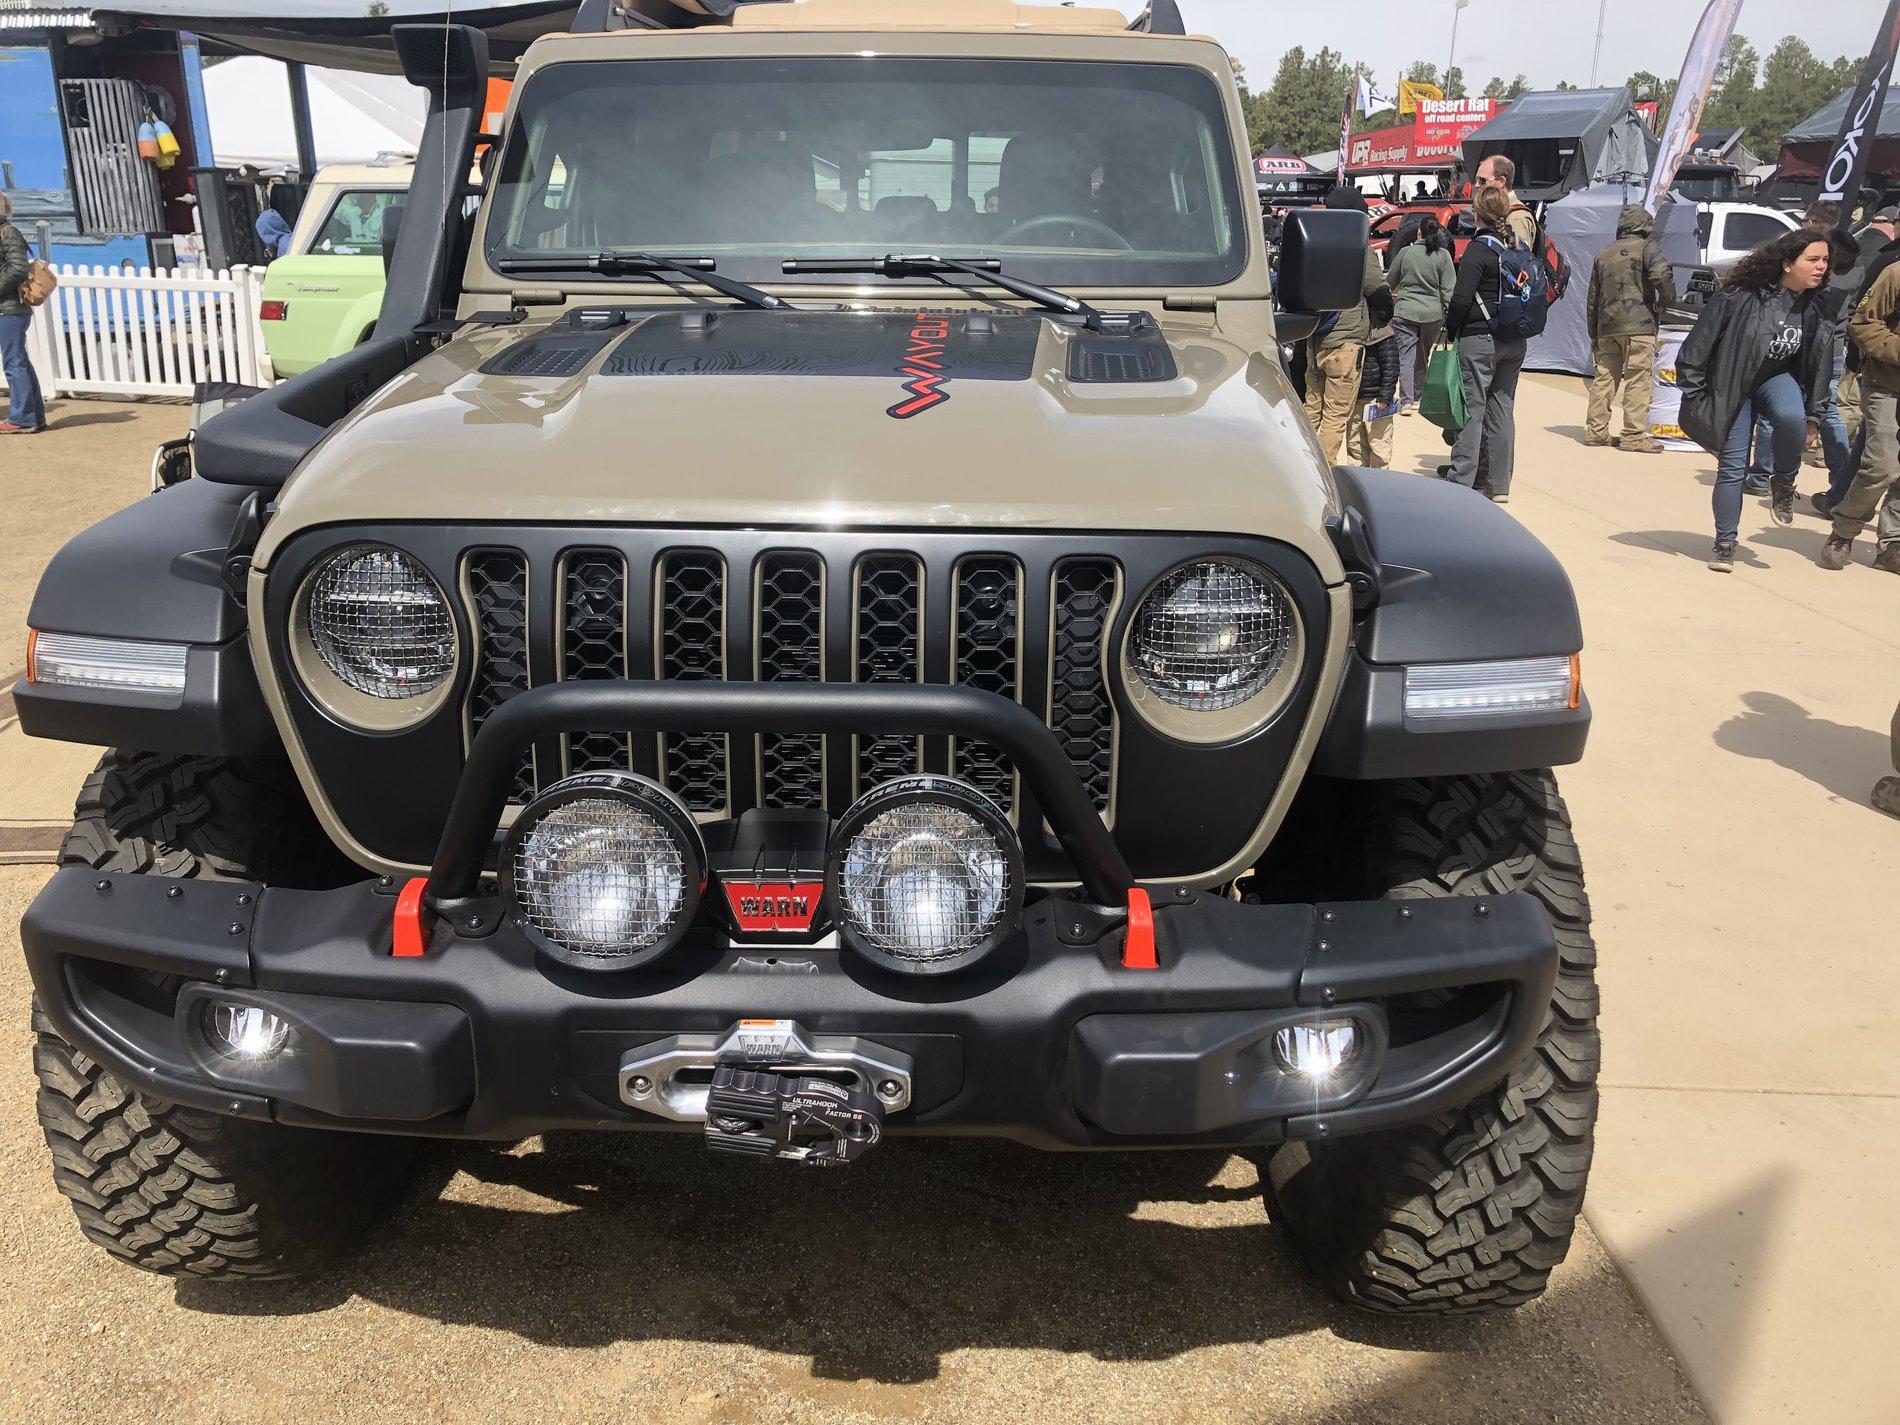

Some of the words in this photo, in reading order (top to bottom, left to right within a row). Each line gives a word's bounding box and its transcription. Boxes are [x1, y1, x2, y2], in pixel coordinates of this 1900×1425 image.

[1422, 99, 1465, 113] Desert
[1424, 114, 1436, 123] off
[1436, 113, 1455, 123] road
[1456, 113, 1487, 122] centers
[1388, 145, 1408, 162] Supply
[740, 895, 808, 918] WARN
[746, 1043, 782, 1055] WARN
[825, 1109, 851, 1119] FACTOR
